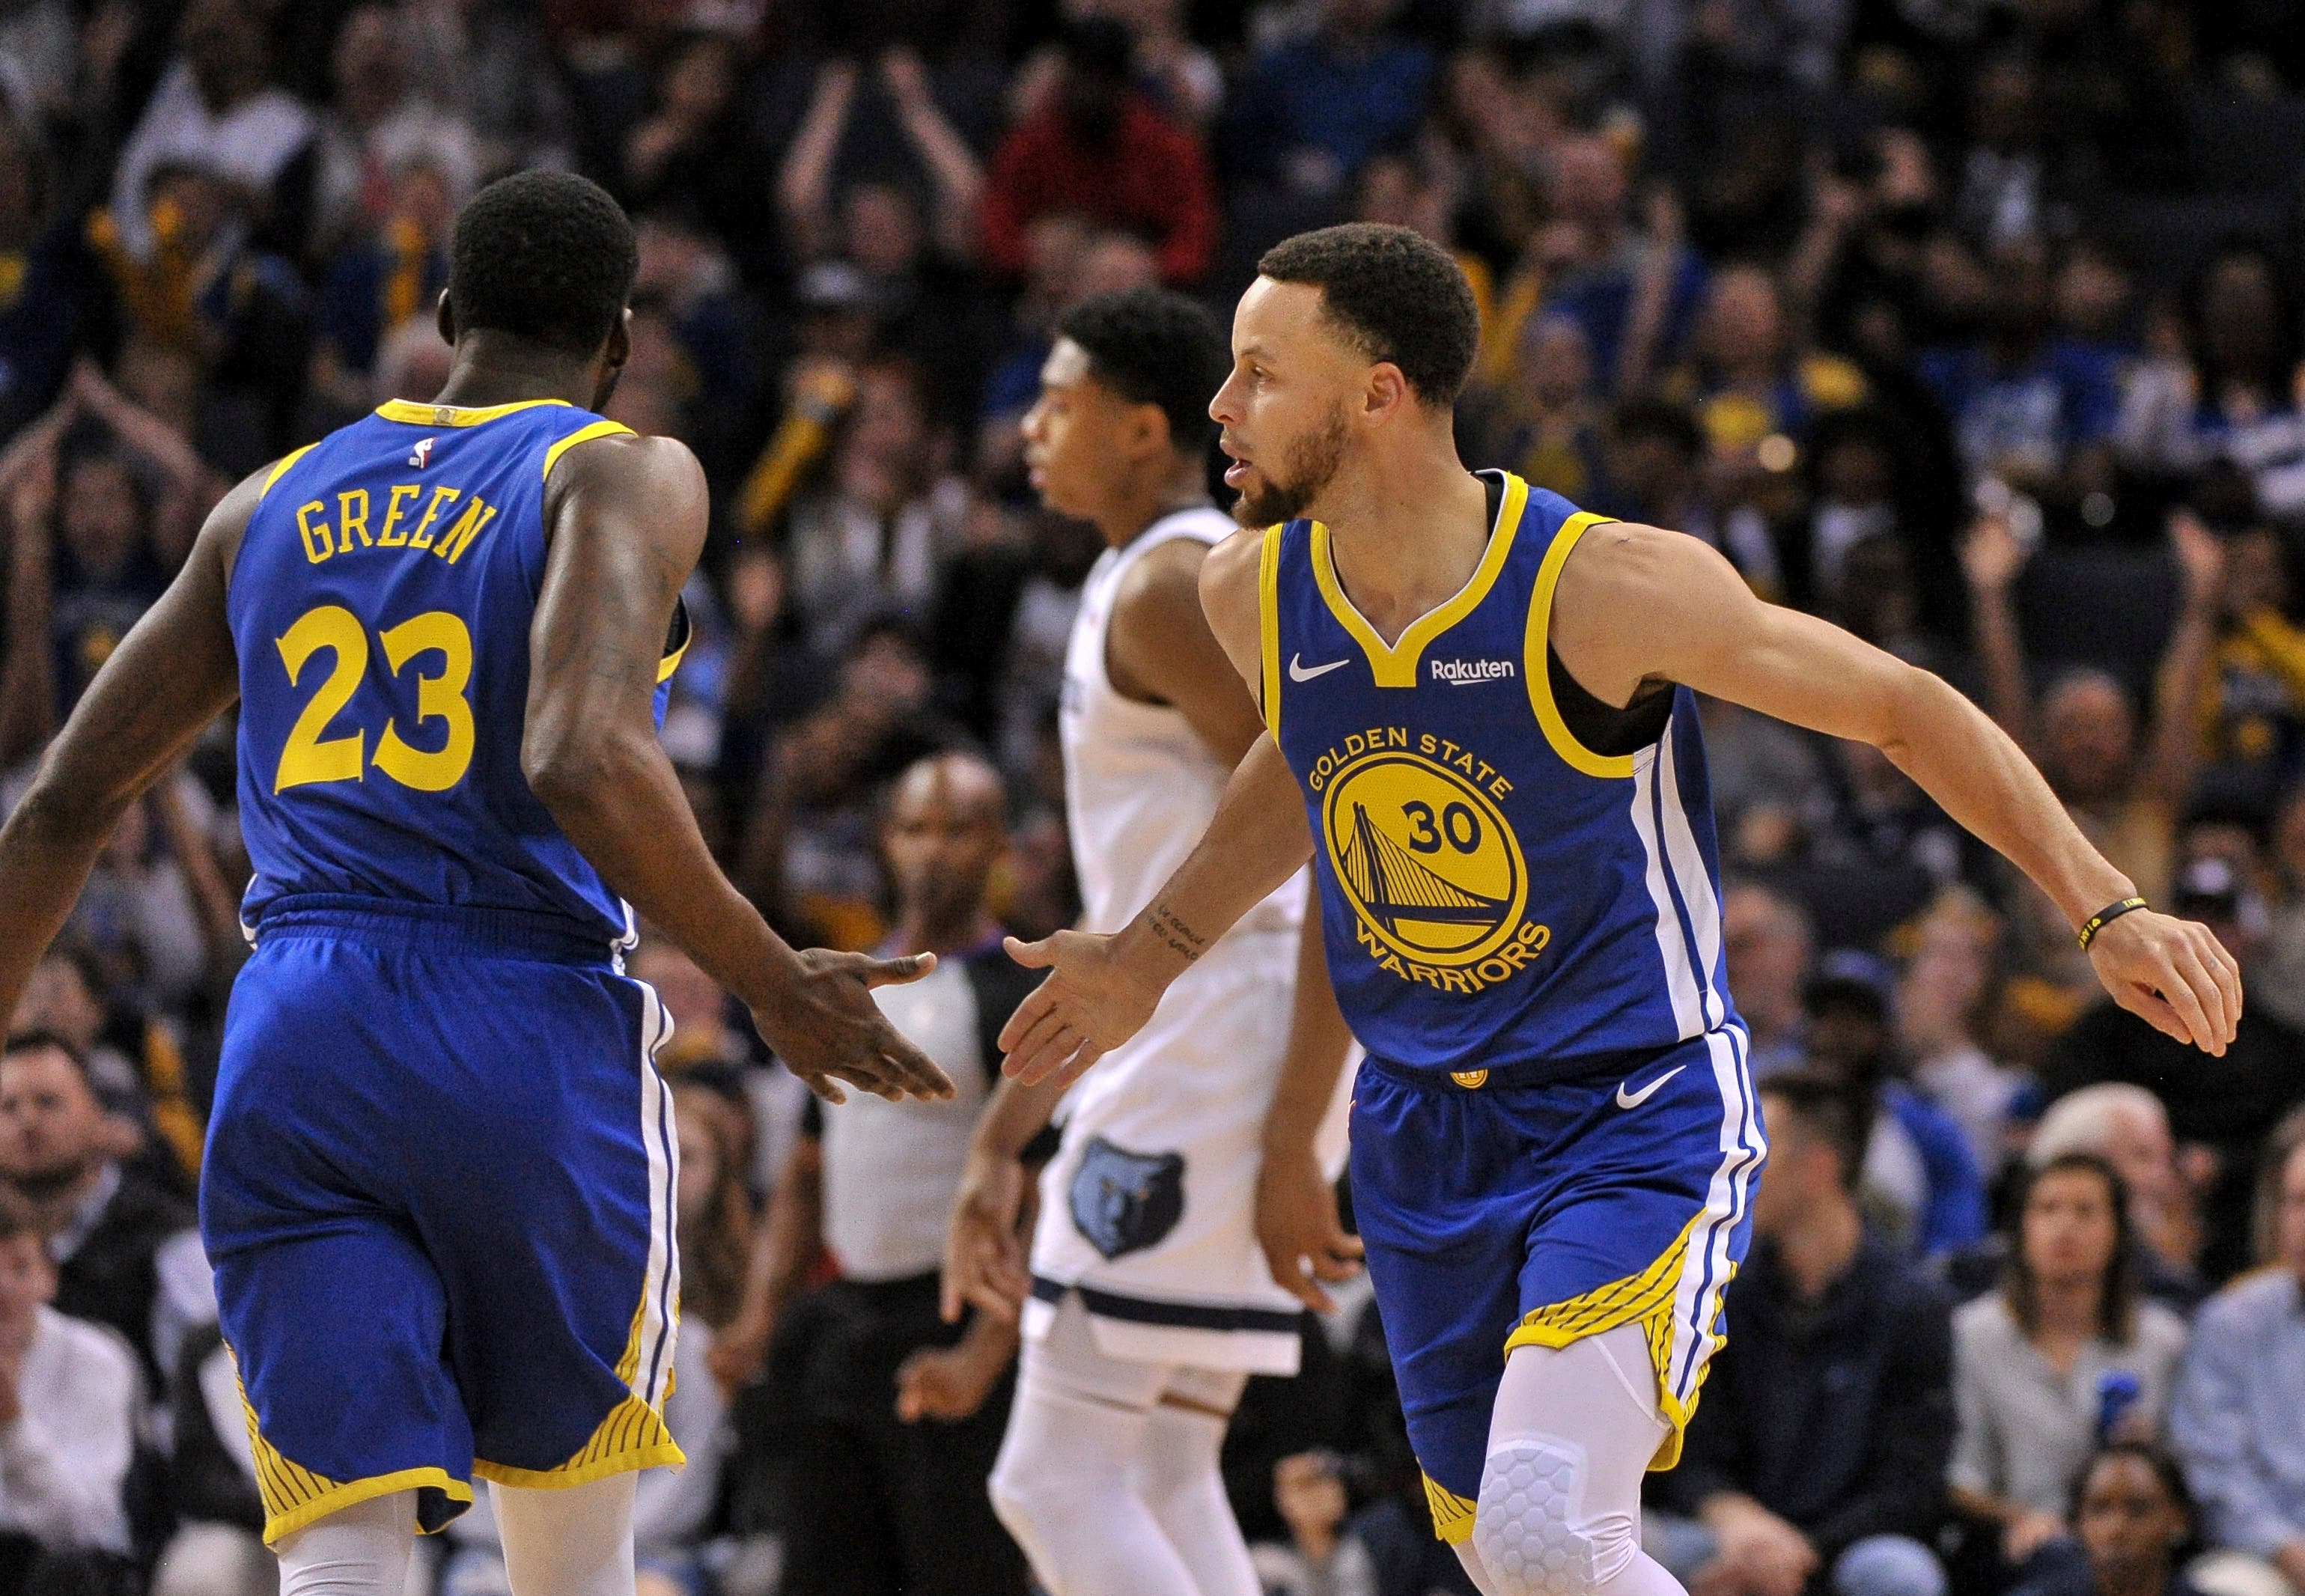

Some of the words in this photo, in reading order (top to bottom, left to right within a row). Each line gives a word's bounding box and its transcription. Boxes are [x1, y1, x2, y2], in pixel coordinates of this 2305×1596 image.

[296, 484, 497, 564] GREEN
[275, 605, 475, 795] 23
[1431, 659, 1514, 680] Rakuten
[1309, 727, 1407, 791] GOLDEN
[1419, 733, 1514, 801] STATE
[1401, 800, 1482, 855] 30
[1356, 916, 1550, 993] WARRIORS
